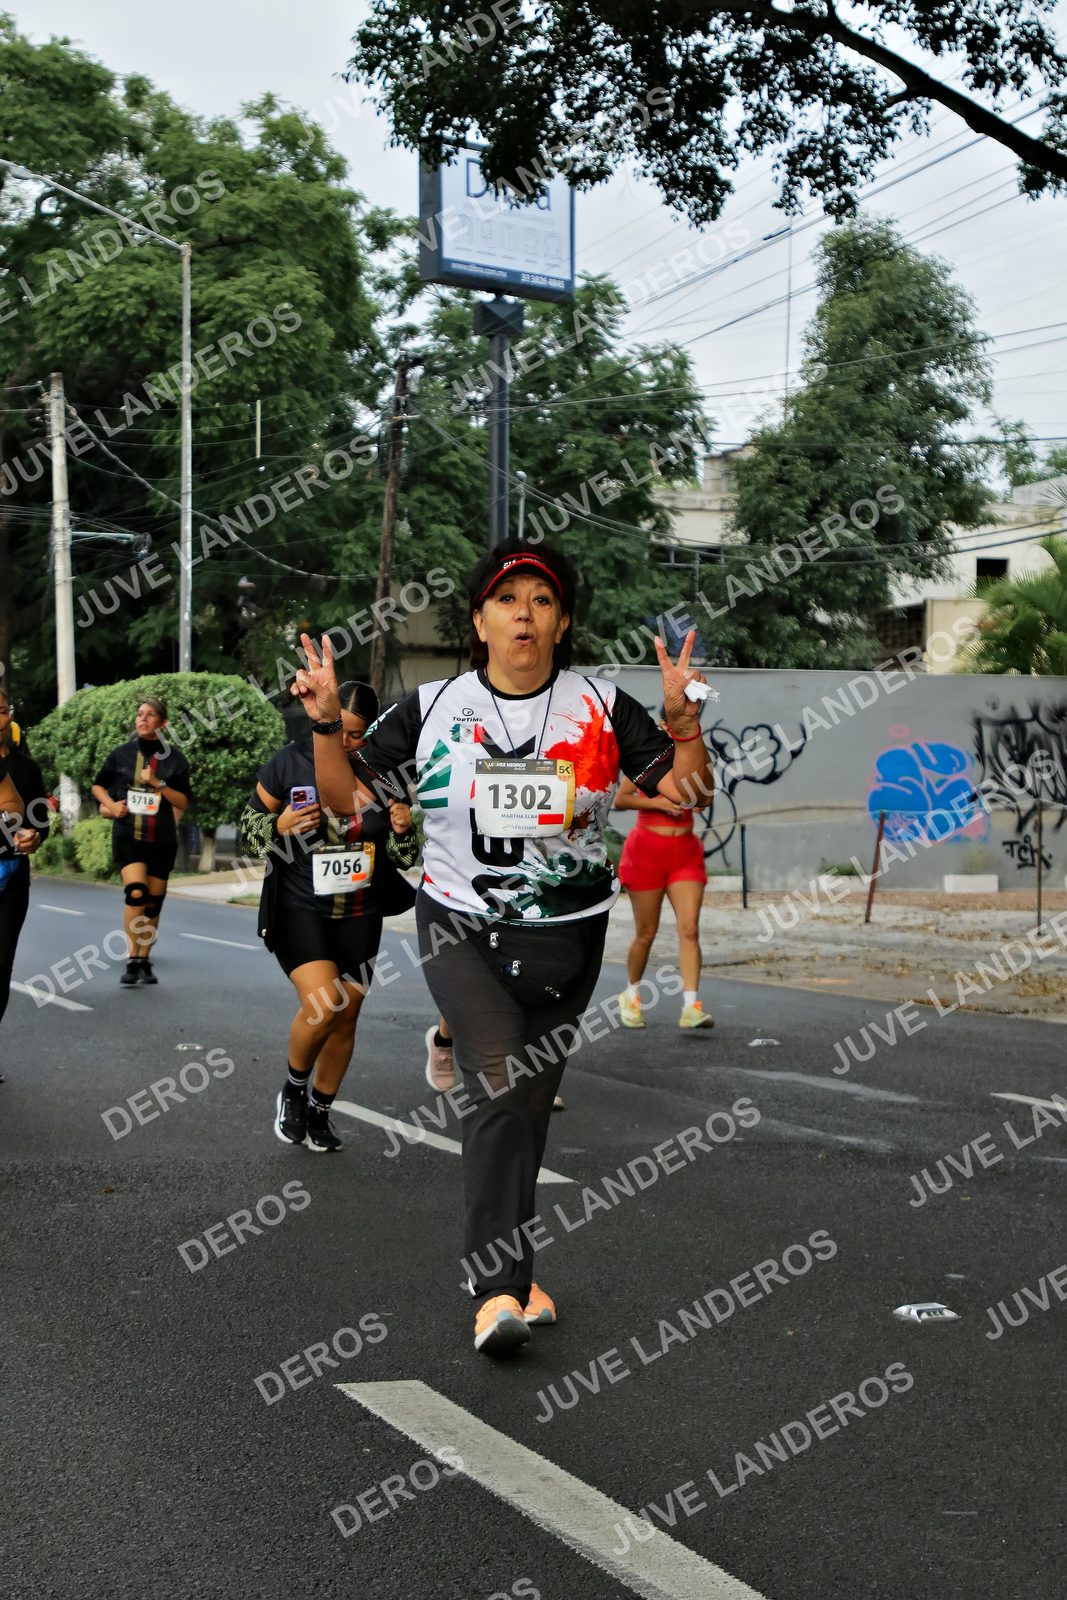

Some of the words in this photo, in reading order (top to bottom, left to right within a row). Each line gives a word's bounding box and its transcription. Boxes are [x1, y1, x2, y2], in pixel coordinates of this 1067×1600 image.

[559, 764, 572, 774] 5K
[132, 795, 154, 805] 5718
[488, 783, 552, 810] 1302
[321, 857, 362, 877] 7056
